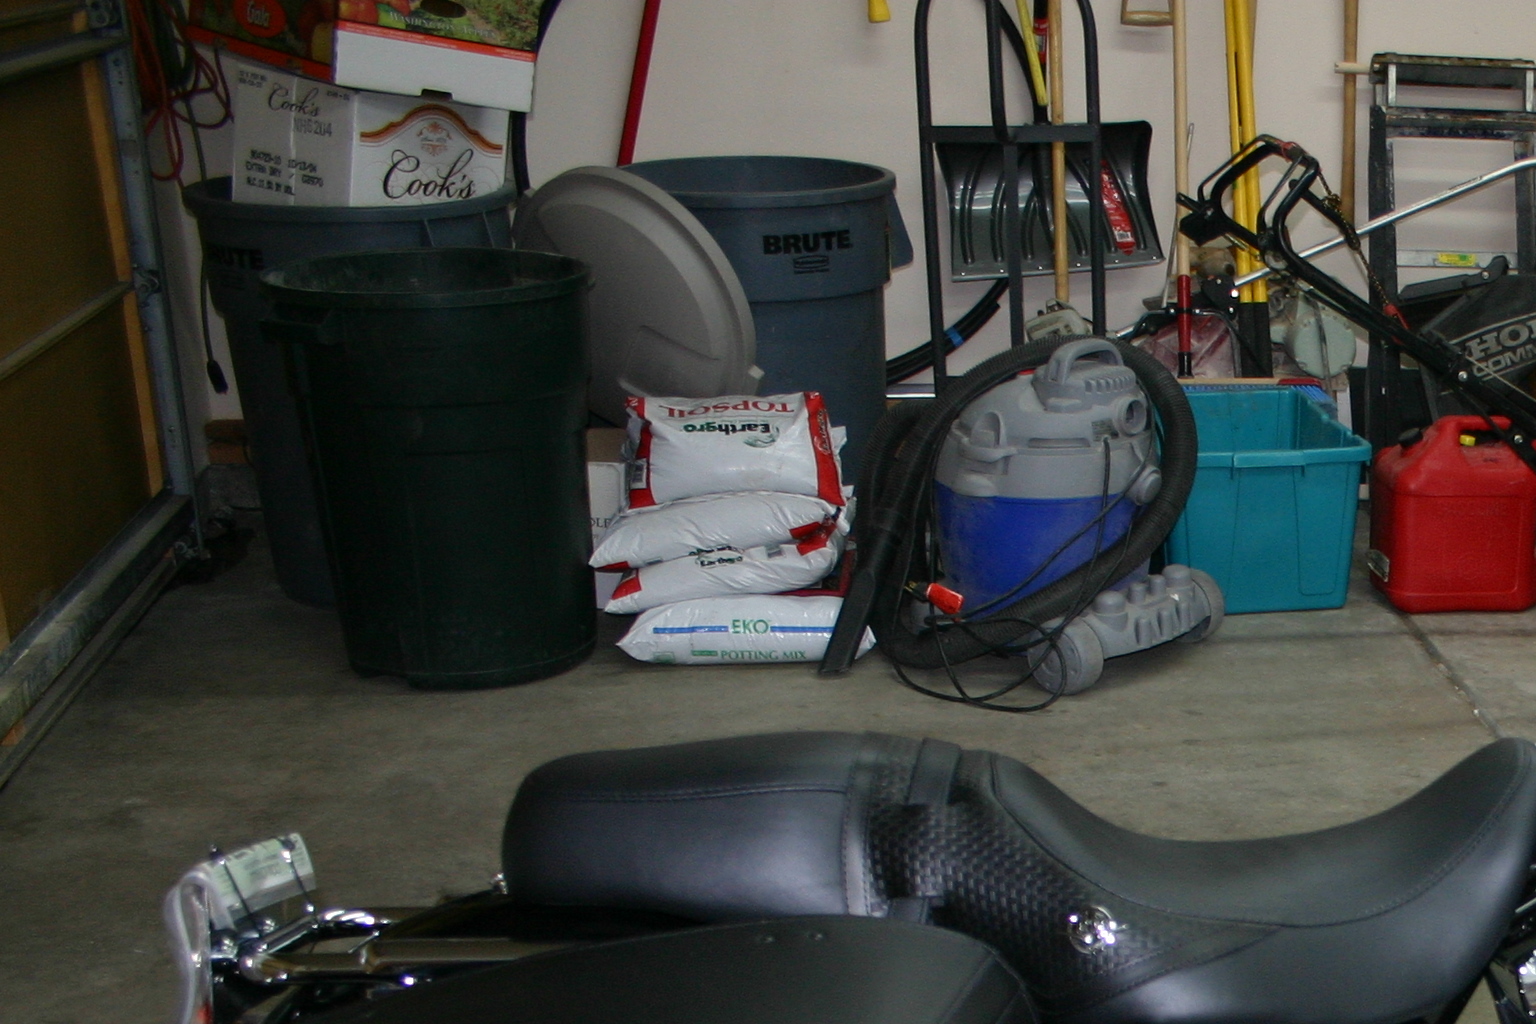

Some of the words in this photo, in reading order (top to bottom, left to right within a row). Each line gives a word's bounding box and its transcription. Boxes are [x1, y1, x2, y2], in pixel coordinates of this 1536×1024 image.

[268, 82, 319, 117] Cook's
[383, 148, 475, 199] Cook's
[763, 229, 853, 255] BRUTE
[659, 399, 795, 418] TOPSOIL
[683, 421, 771, 436] Earthgro
[731, 619, 769, 634] EKO
[721, 650, 779, 660] POTTING
[782, 650, 808, 660] MIX
